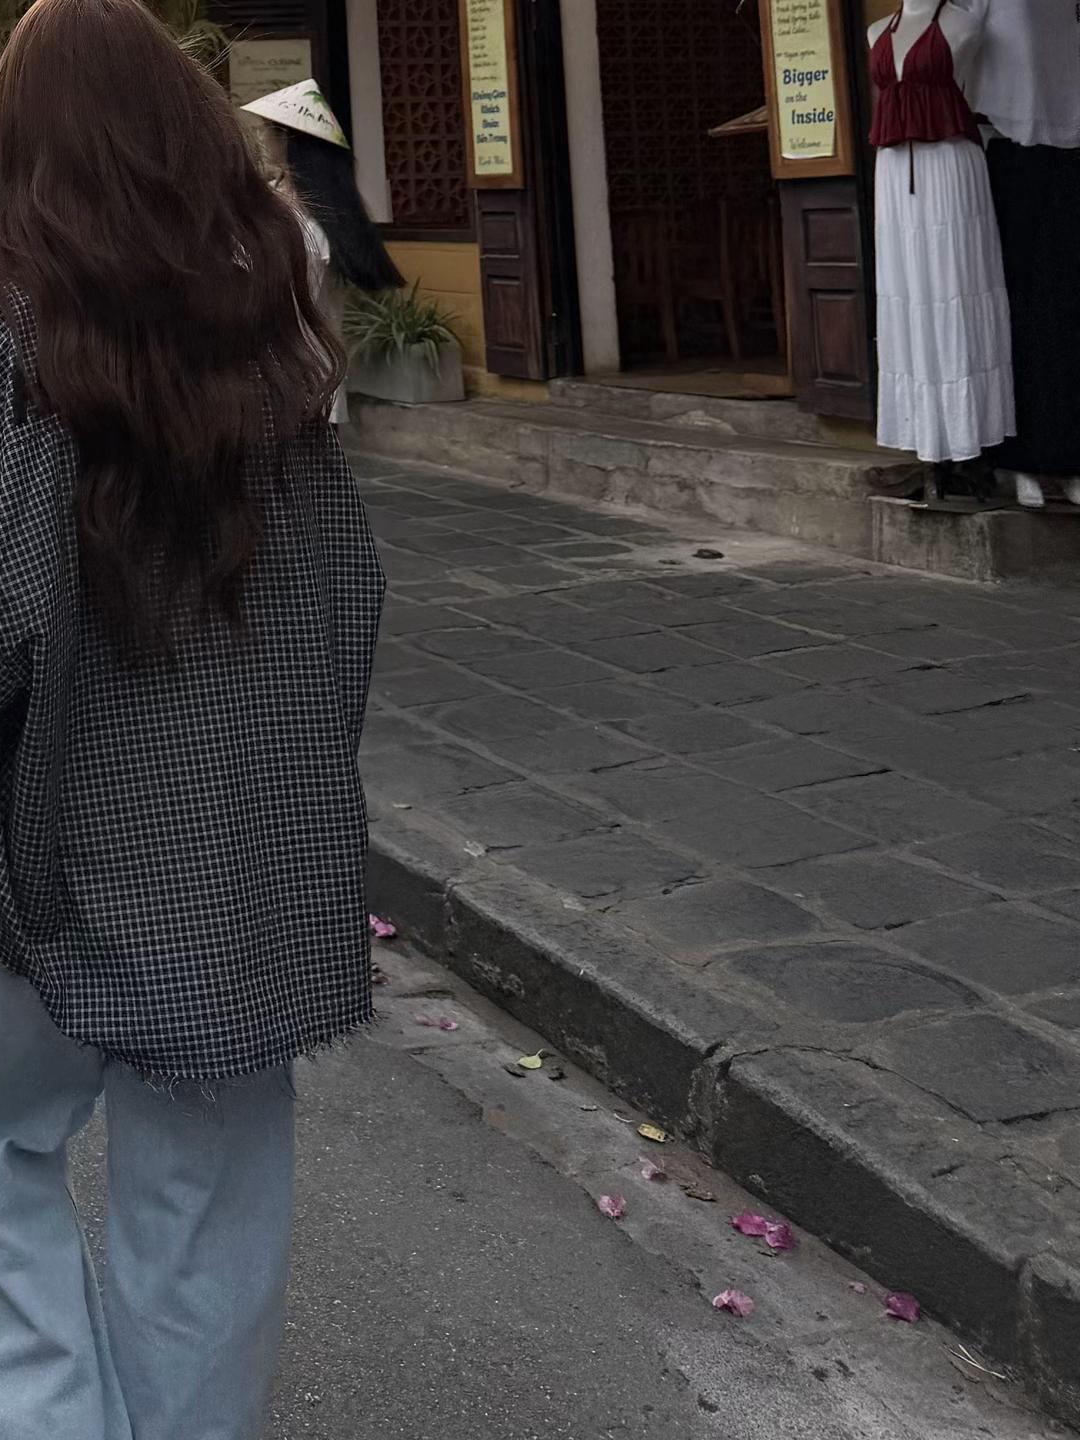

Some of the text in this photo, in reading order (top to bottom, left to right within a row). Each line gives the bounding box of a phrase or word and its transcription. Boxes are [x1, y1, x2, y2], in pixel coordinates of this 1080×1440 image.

[782, 68, 829, 87] Bigger
[795, 91, 808, 103] the
[791, 107, 834, 125] Inside
